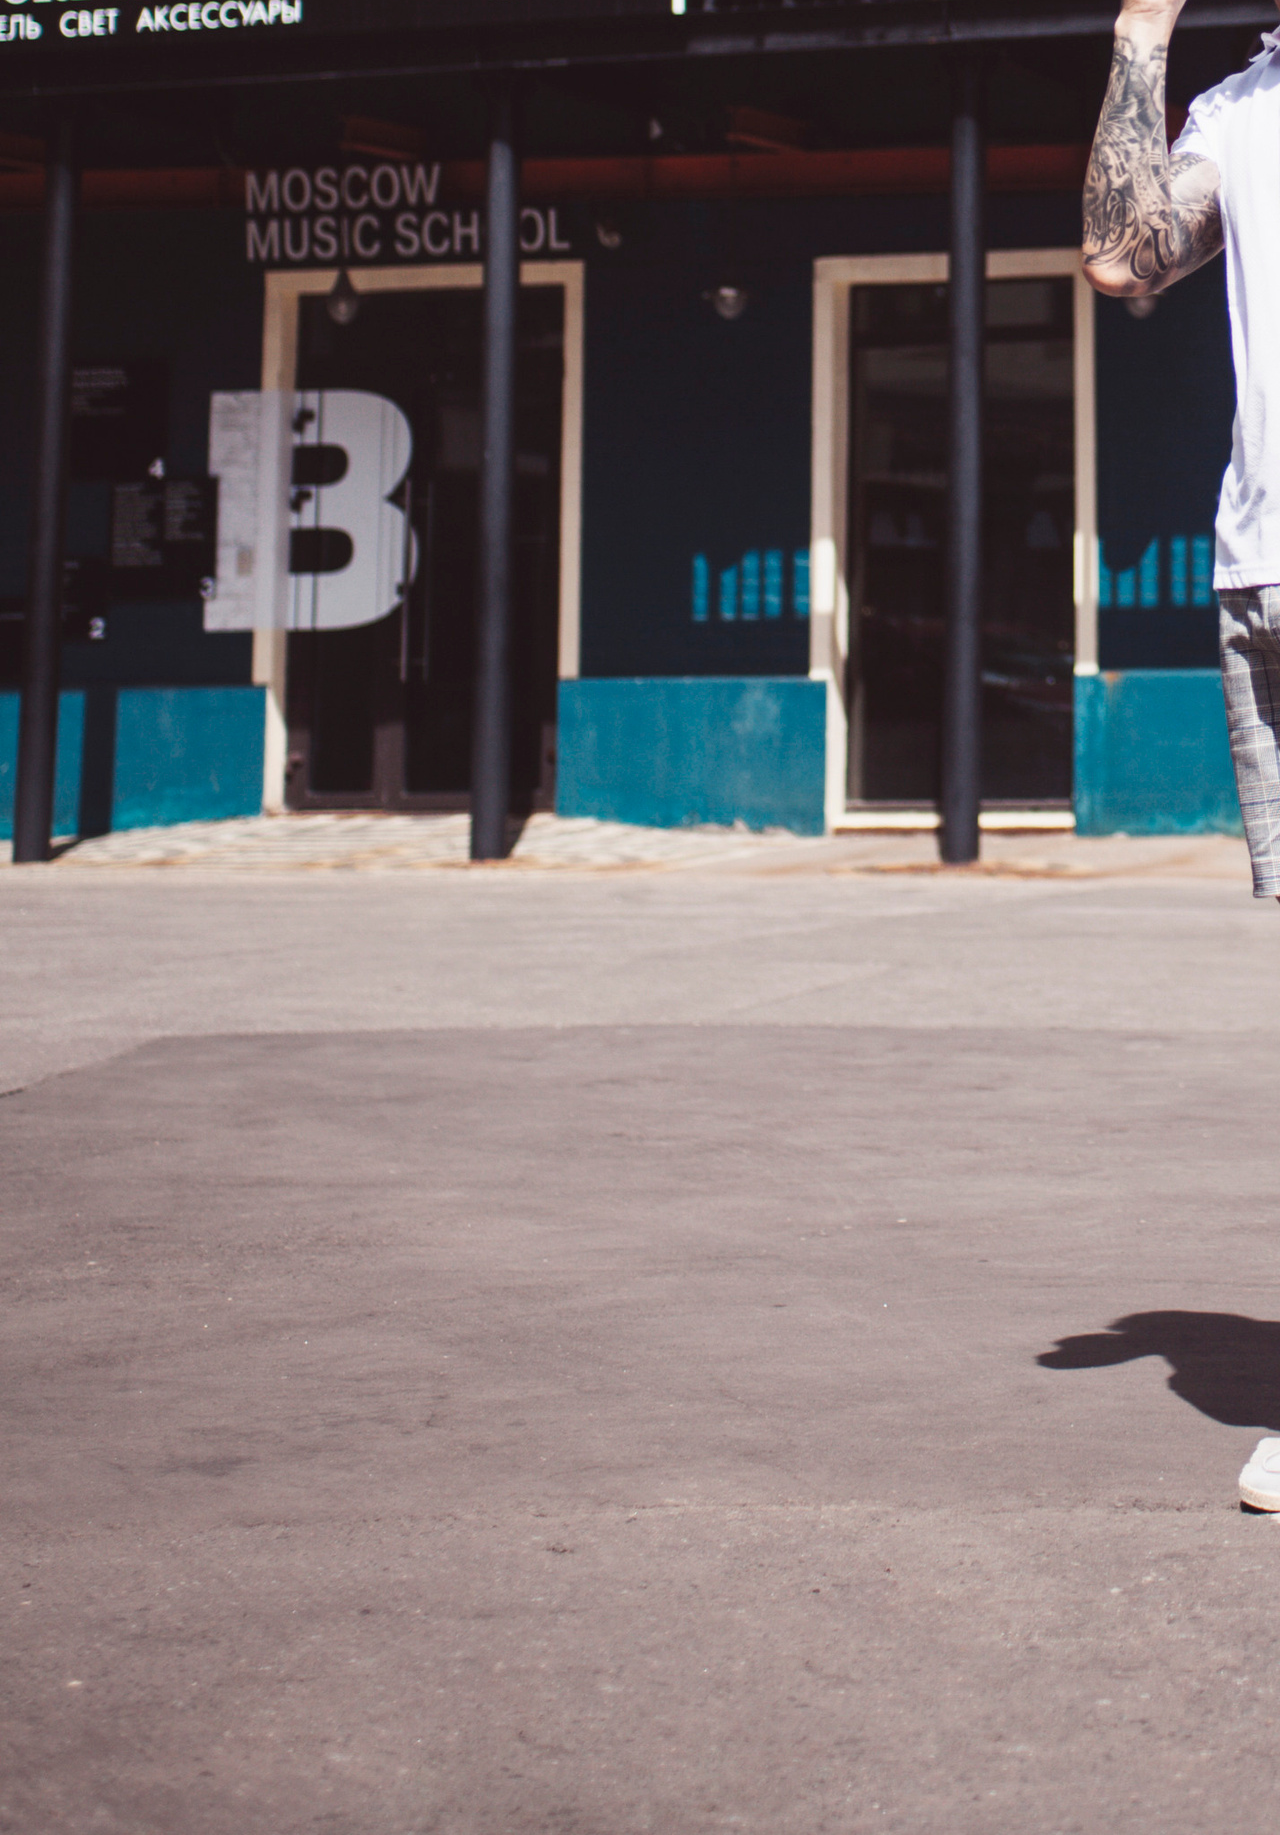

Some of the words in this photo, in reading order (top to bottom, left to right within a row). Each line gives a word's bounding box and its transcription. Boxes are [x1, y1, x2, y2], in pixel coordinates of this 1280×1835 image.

[59, 8, 120, 39] СВЕТ
[246, 164, 441, 212] MOSCOW
[246, 212, 381, 261] MUSIC
[395, 207, 570, 256] SCHOL
[149, 457, 165, 480] 4
[89, 617, 105, 639] 2
